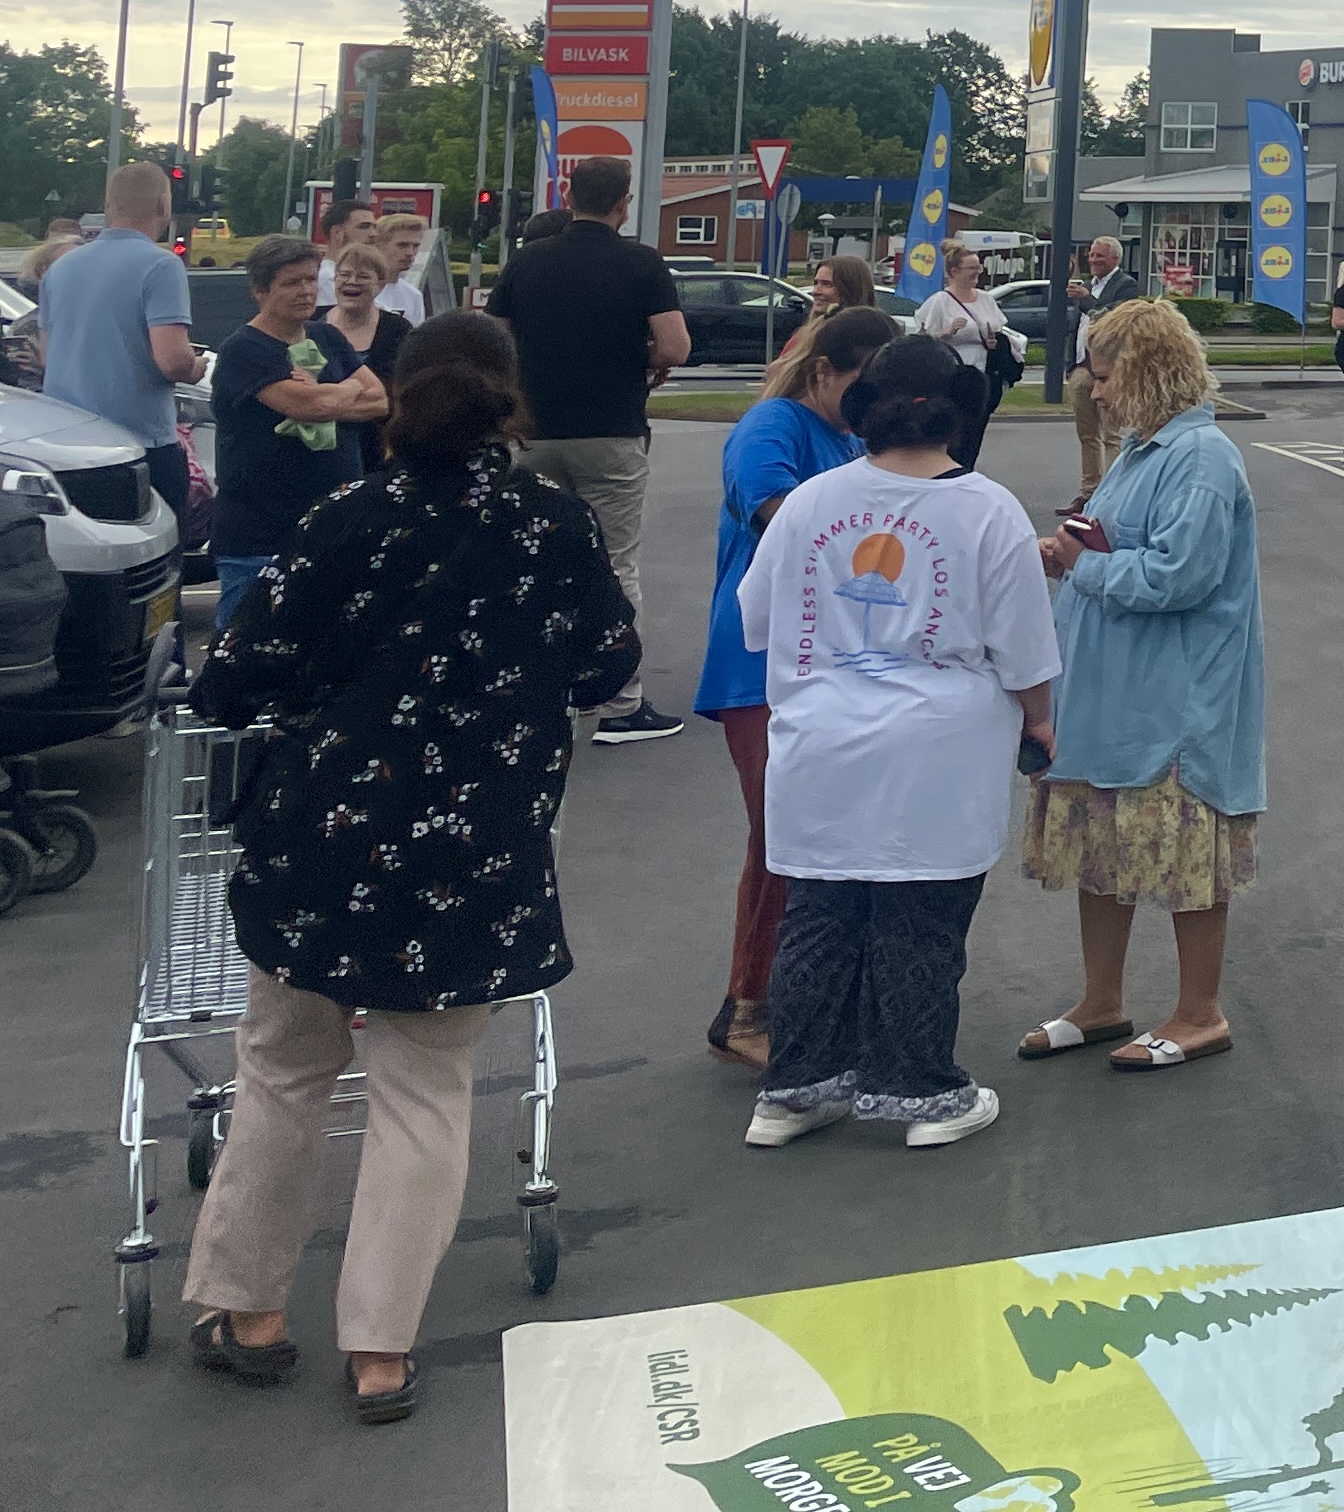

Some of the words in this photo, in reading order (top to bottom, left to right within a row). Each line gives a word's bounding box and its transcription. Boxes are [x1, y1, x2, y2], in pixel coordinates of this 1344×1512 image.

[562, 48, 629, 62] BILVASK
[797, 587, 817, 677] ENDLESS
[883, 514, 940, 550] PARTY
[932, 557, 949, 598] LOS
[646, 1349, 701, 1445] lidl.dk/CSR
[872, 1432, 942, 1464] PÅ
[815, 1450, 895, 1495] MOD
[864, 1490, 913, 1508] I
[902, 1455, 972, 1491] VEJ
